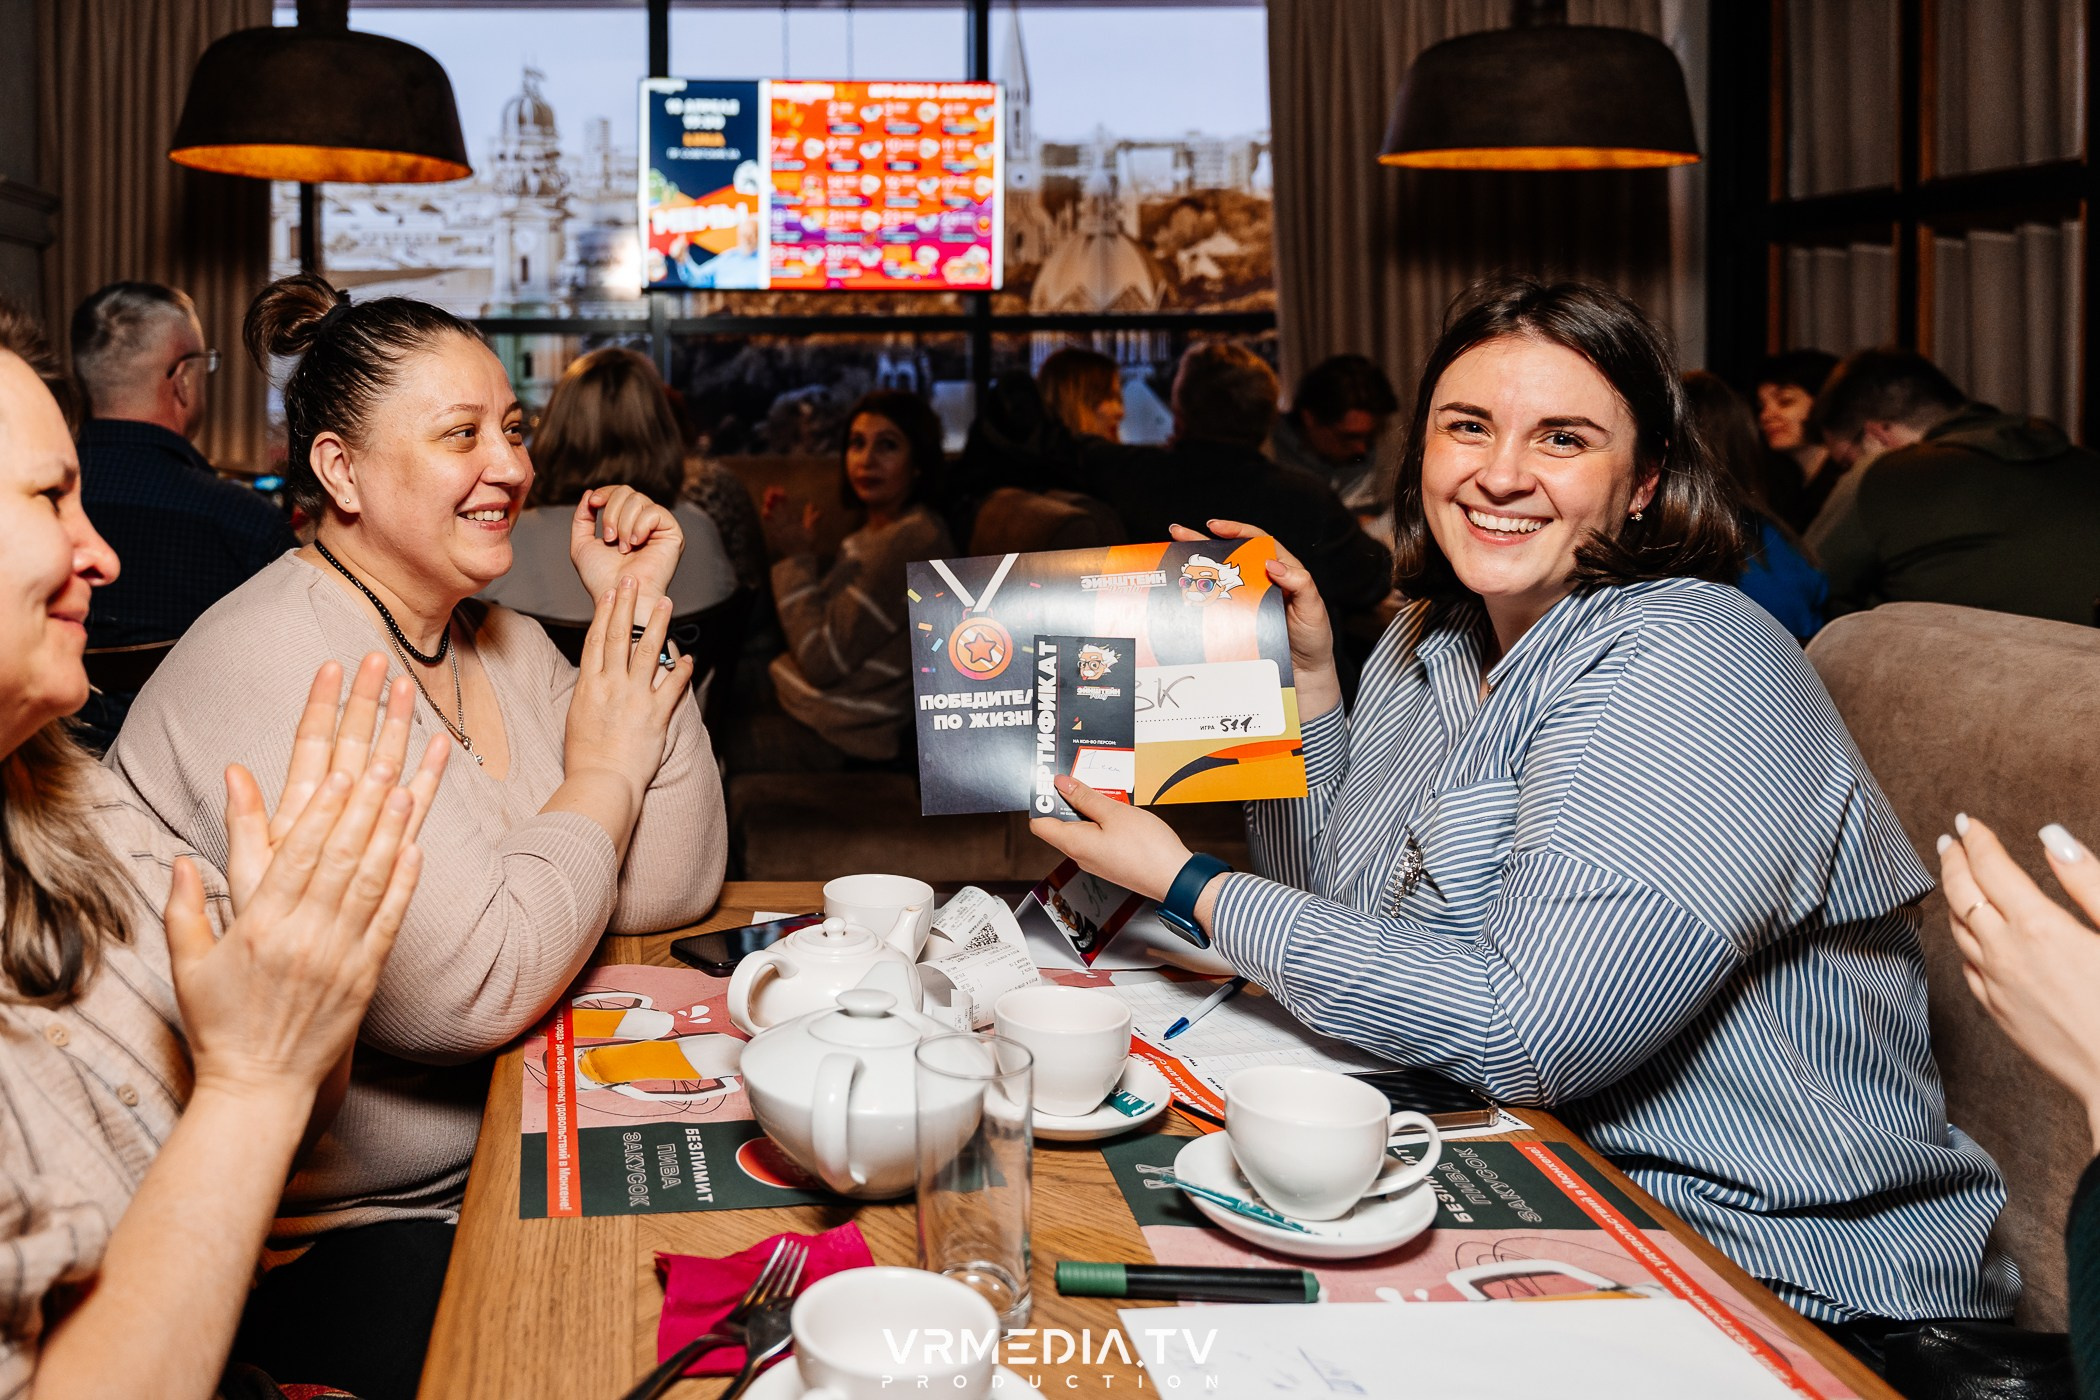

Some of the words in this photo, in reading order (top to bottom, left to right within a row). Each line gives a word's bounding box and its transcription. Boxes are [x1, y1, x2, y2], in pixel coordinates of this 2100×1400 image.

[933, 714, 963, 730] ПО
[1035, 640, 1057, 813] СЕРТИФИКАТ
[555, 1023, 565, 1041] среда
[555, 1044, 565, 1056] дни
[554, 1056, 567, 1103] безграничных
[556, 1103, 572, 1162] удовольствий
[622, 1131, 651, 1207] ЗАКУСОК
[656, 1143, 682, 1189] ПИВА
[685, 1128, 714, 1203] БЕЗЛИМИТ
[1437, 1161, 1492, 1205] ПИВА
[1453, 1147, 1543, 1223] ЗАКУСОК
[1524, 1145, 1580, 1191] Мюнхене!
[559, 1167, 572, 1211] Мюнхене!
[1574, 1189, 1585, 1197] в
[1580, 1196, 1668, 1268] удовольствий
